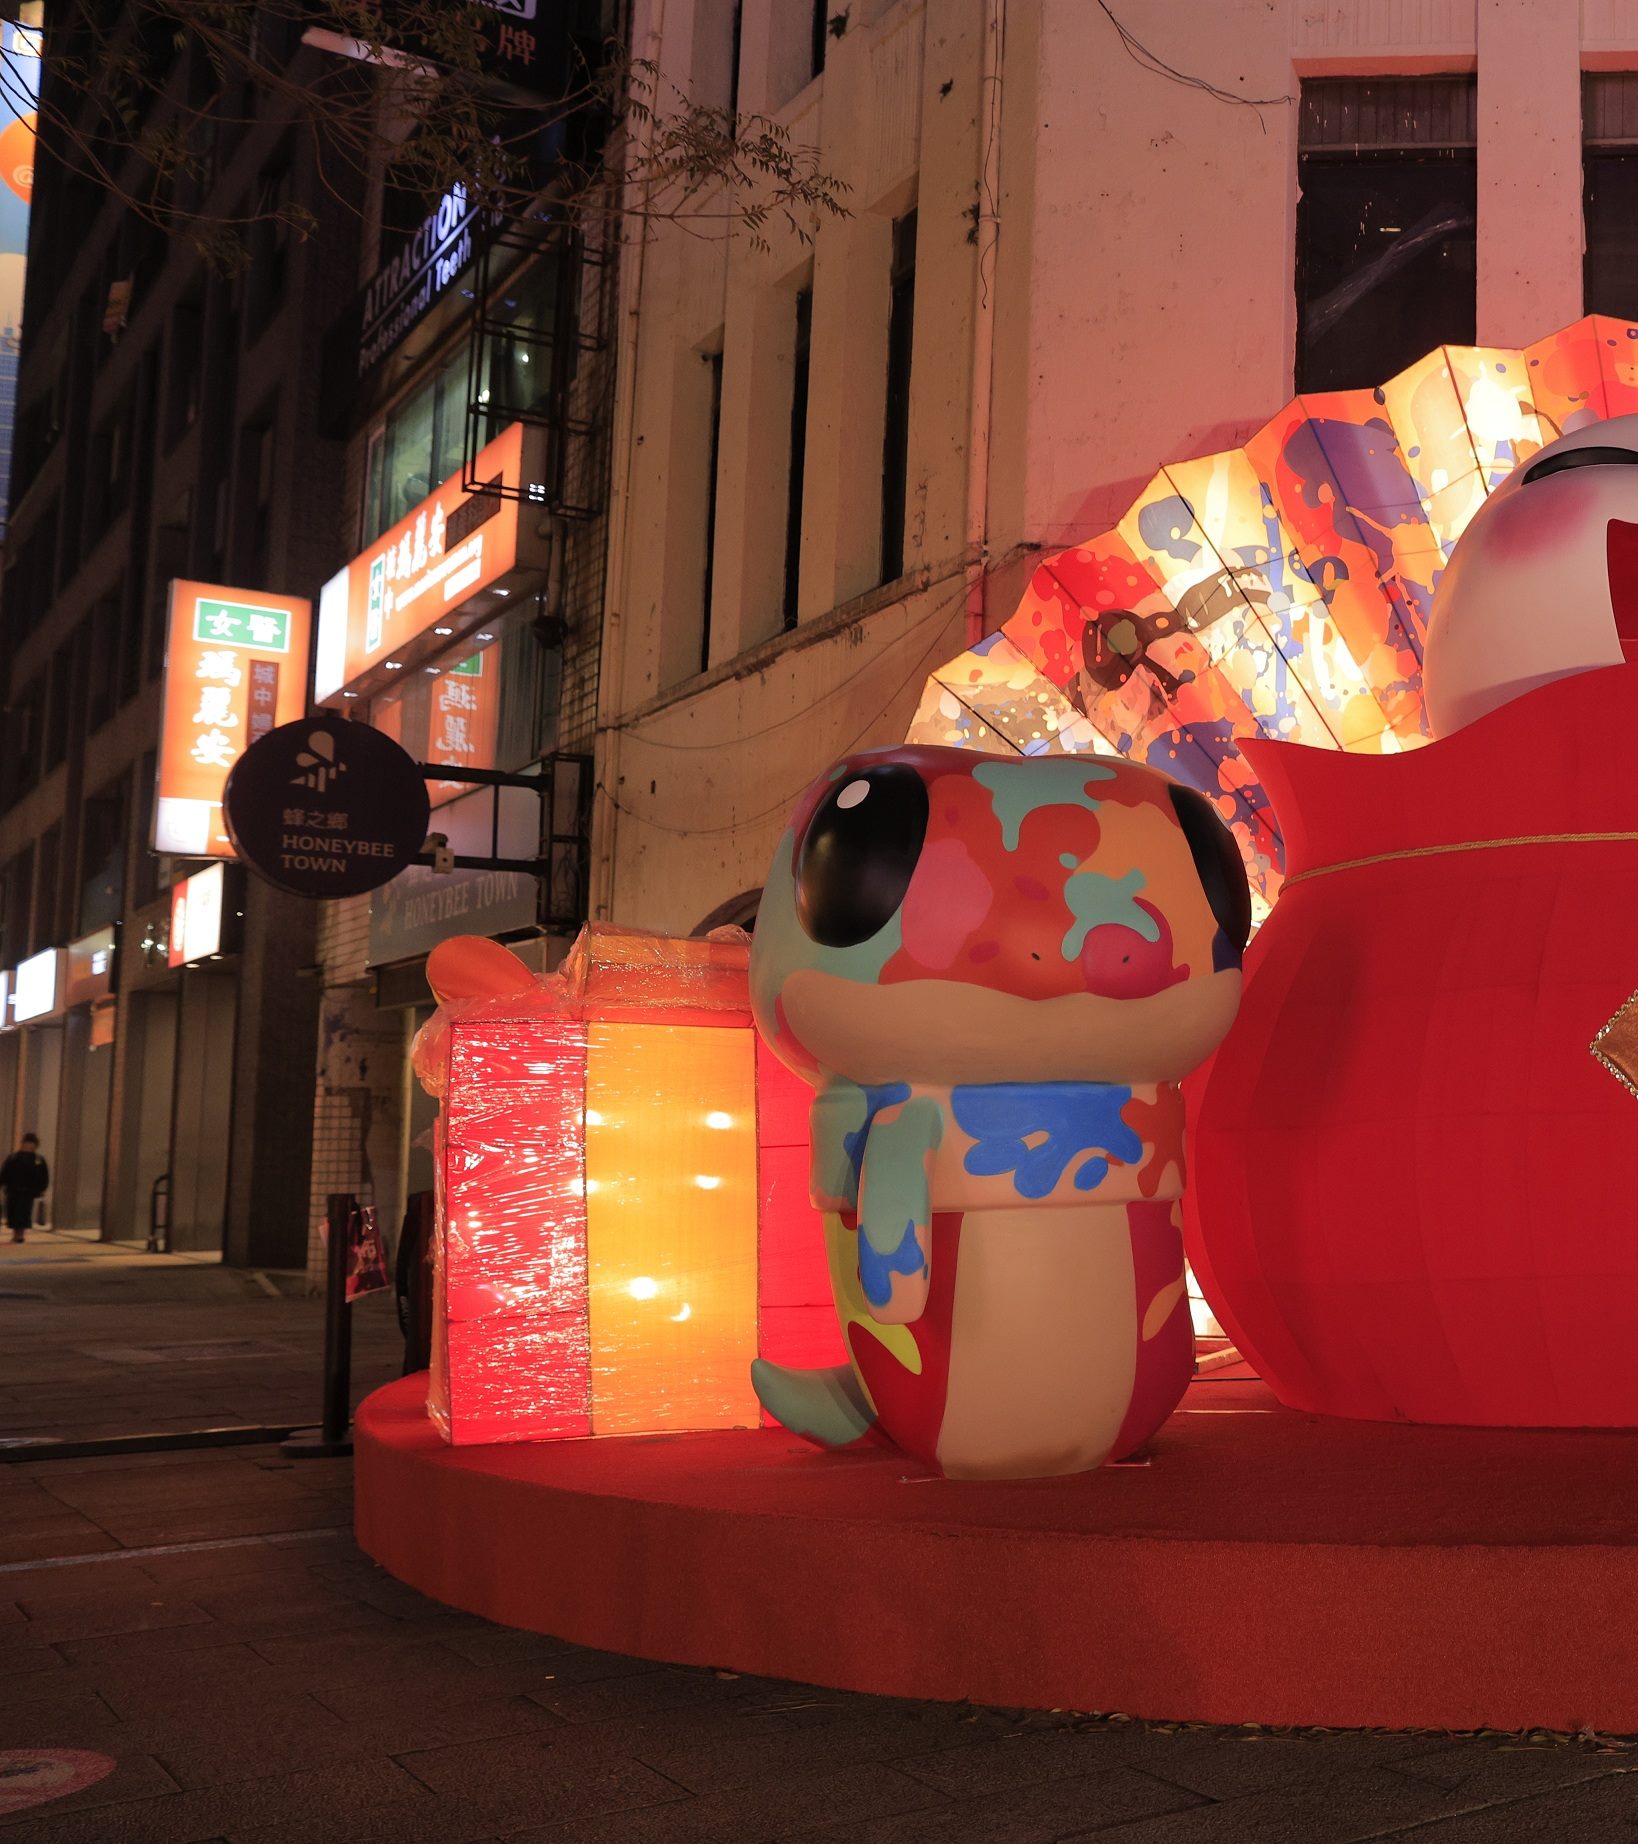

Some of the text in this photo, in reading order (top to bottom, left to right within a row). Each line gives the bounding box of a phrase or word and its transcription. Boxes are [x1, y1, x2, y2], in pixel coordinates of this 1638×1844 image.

[205, 609, 282, 643] 女醫
[191, 651, 242, 767] 瑪麗安
[283, 834, 394, 857] HONEYBEE
[280, 854, 347, 872] TOWN
[404, 881, 470, 930] HONEYBEE
[475, 871, 519, 909] TOWN
